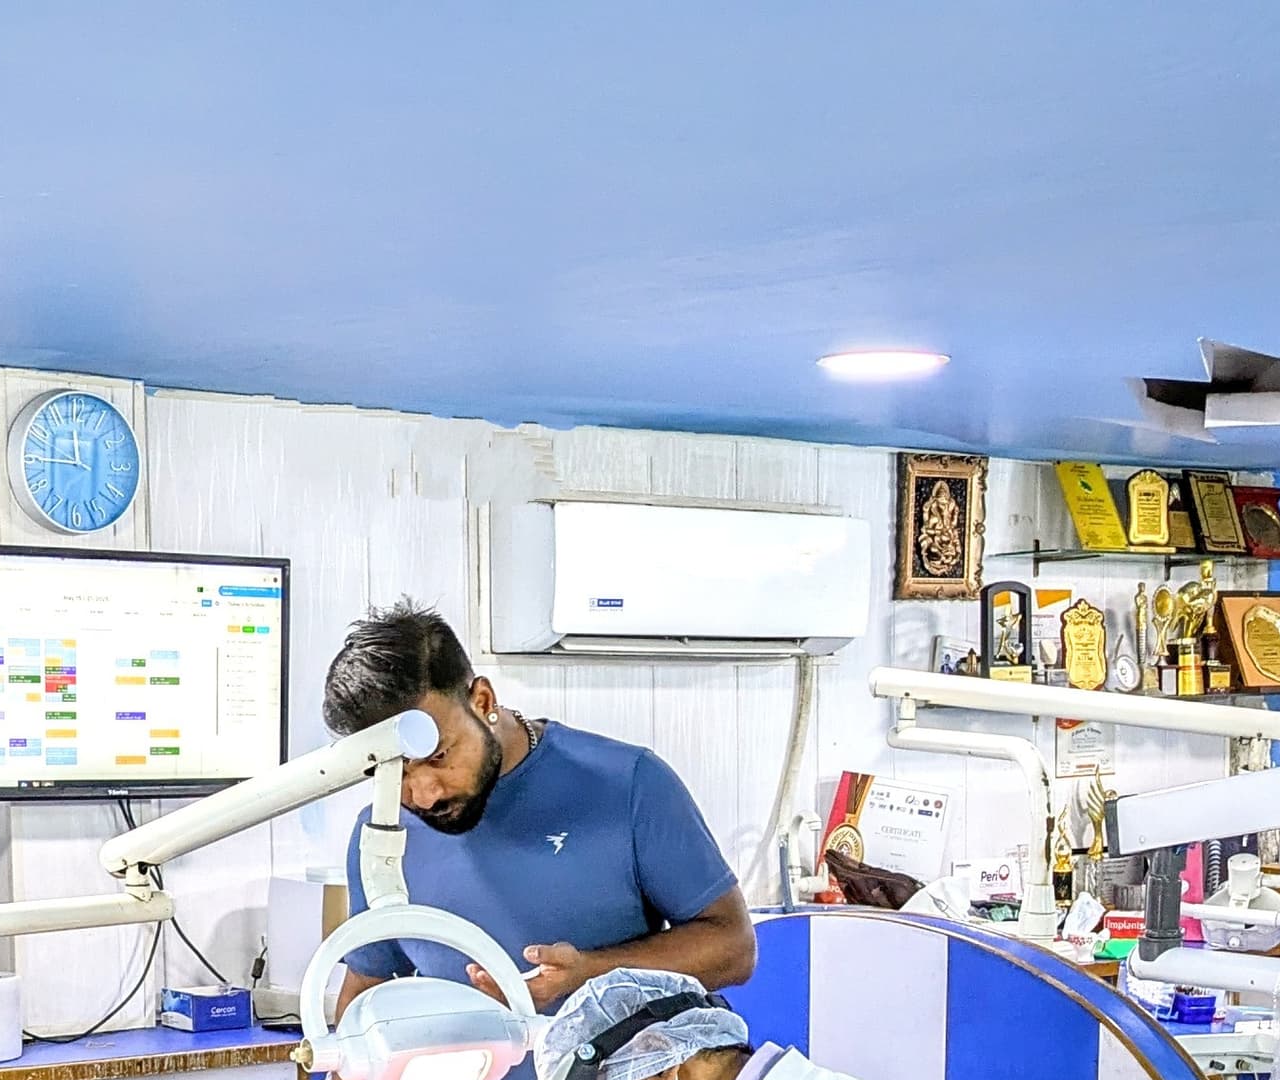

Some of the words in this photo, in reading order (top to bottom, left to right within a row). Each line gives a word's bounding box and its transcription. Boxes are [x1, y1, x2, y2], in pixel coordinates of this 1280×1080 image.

[48, 404, 65, 427] 11
[72, 398, 85, 424] 12
[93, 409, 107, 432] 1
[29, 424, 50, 447] 10
[104, 432, 126, 450] 2
[110, 462, 132, 472] 3
[29, 479, 49, 494] 8
[105, 482, 125, 500] 4
[47, 495, 64, 516] 7
[72, 502, 82, 527] 6
[91, 498, 107, 521] 5
[881, 825, 922, 838] CERTIFICATE
[1107, 919, 1146, 931] Implants
[211, 1006, 236, 1014] Cercon
